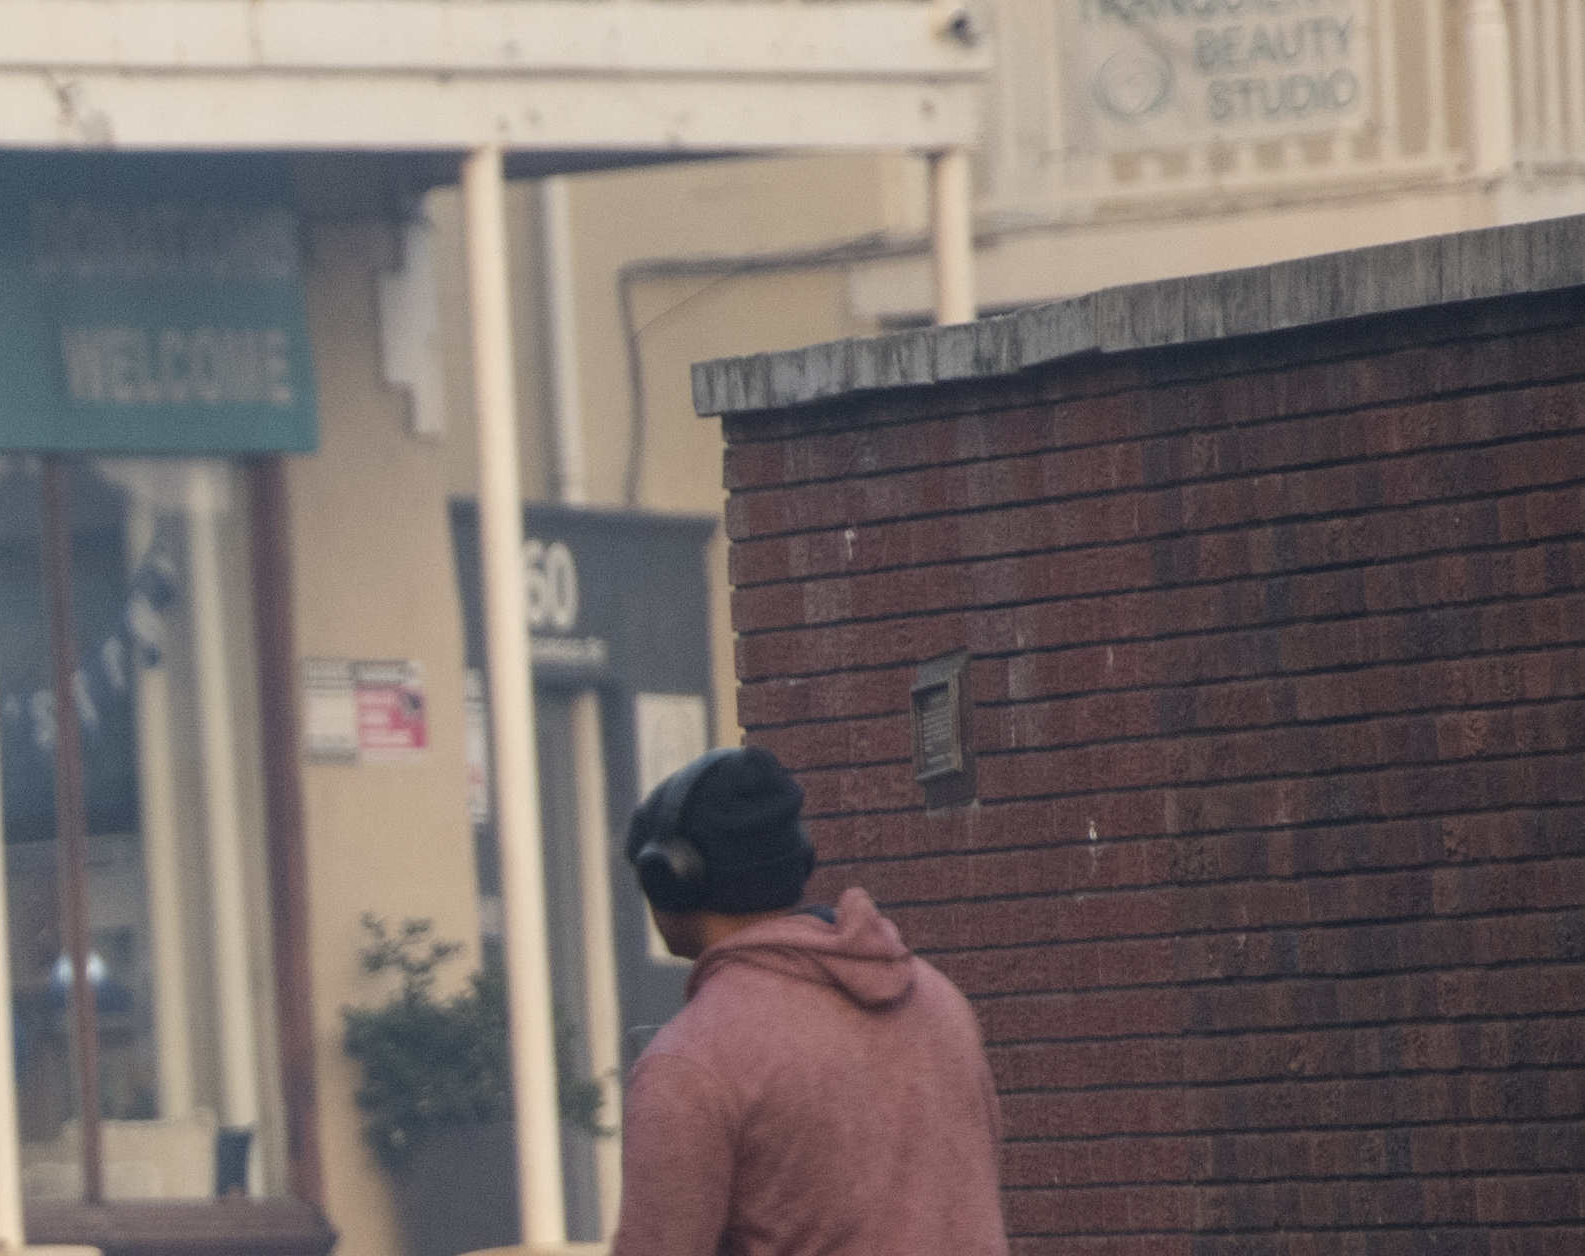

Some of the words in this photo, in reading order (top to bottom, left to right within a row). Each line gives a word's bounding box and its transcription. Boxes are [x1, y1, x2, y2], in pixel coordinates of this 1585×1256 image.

[1193, 15, 1353, 74] BEAUTY
[1208, 69, 1360, 122] STUDIO
[63, 327, 292, 402] WELCOME
